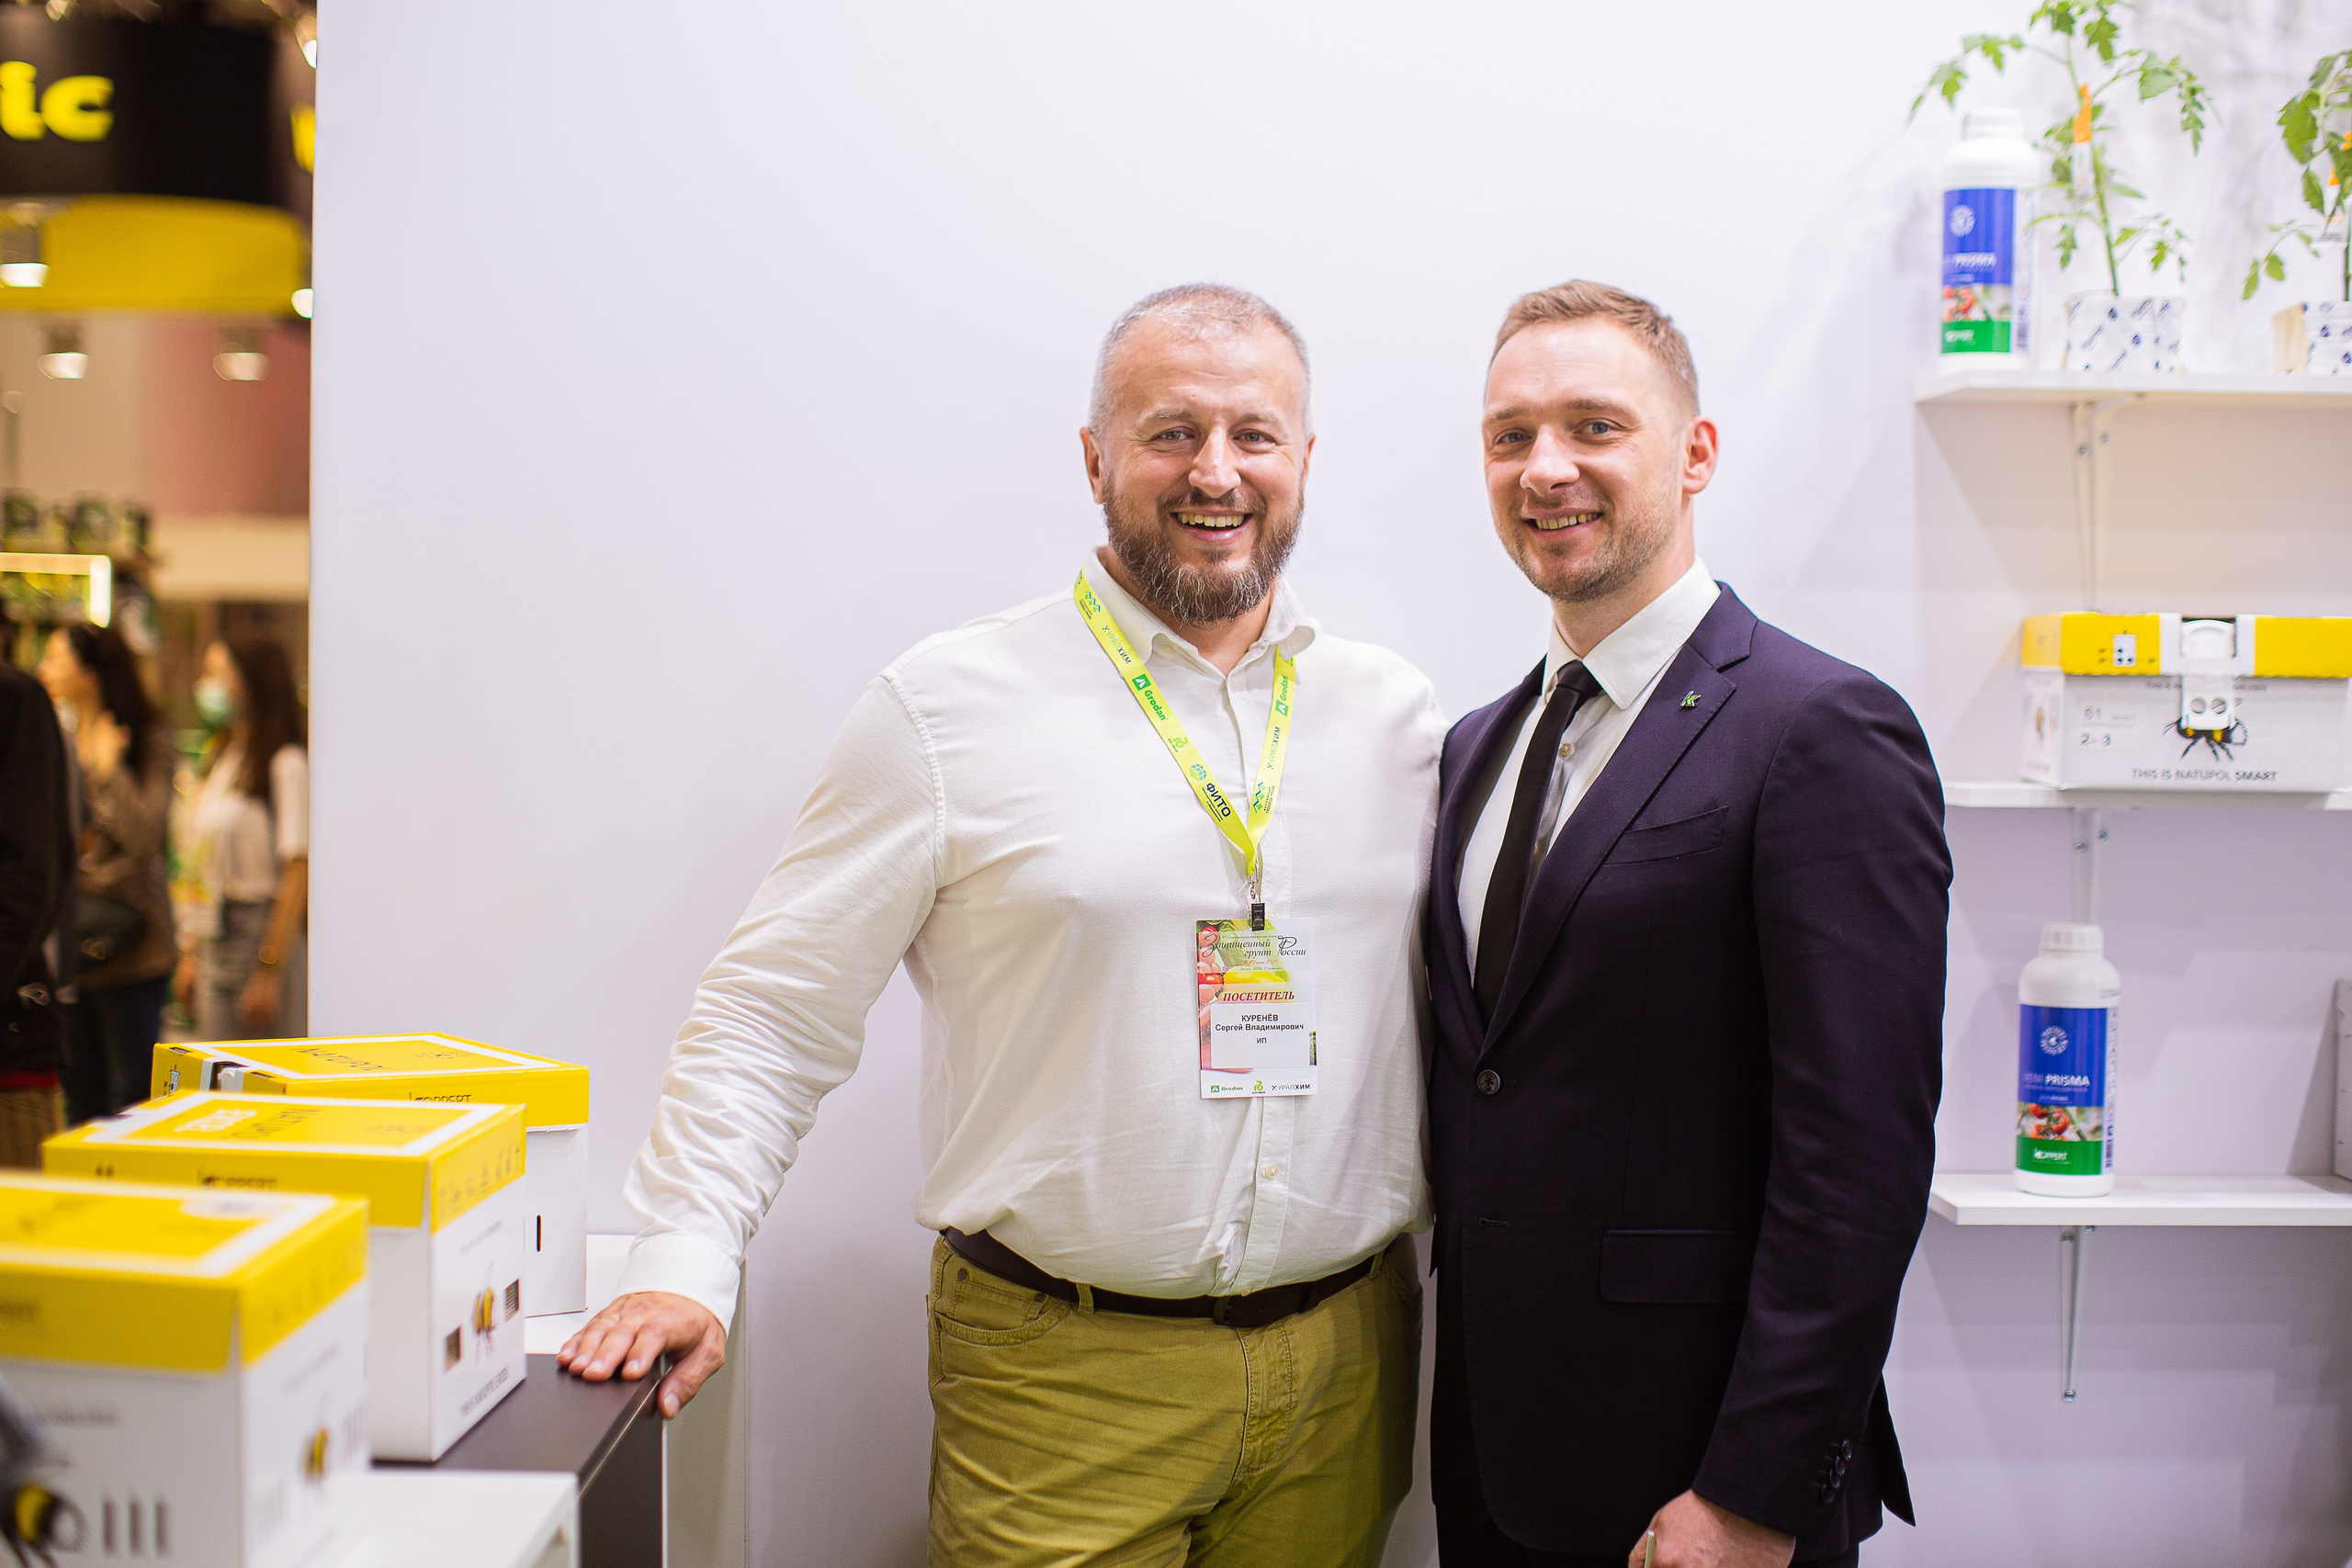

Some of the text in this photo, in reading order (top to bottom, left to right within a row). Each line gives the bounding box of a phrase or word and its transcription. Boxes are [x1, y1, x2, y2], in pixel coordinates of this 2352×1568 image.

[1280, 675, 1288, 701] Grodan
[1144, 690, 1167, 721] Grodan
[1206, 783, 1231, 817] ФИТО
[1244, 950, 1272, 958] грунт
[1223, 991, 1295, 1002] ПОСЕТИТЕЛЬ
[1241, 1013, 1279, 1021] КУРЕНЁВ
[1215, 1022, 1304, 1032] Сергей Владимирович
[2045, 1074, 2091, 1087] PRISMA
